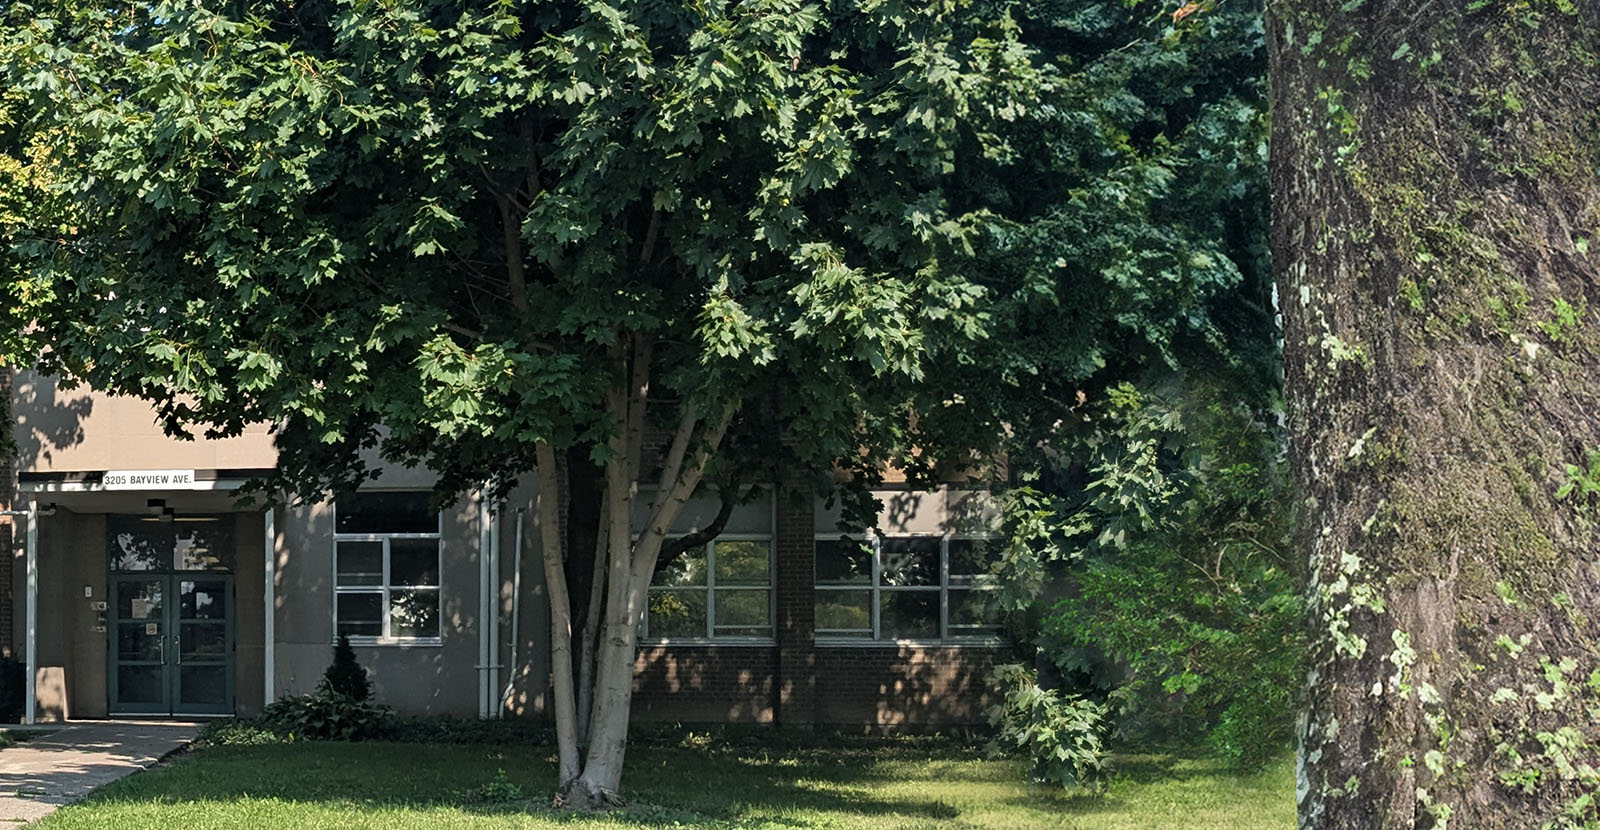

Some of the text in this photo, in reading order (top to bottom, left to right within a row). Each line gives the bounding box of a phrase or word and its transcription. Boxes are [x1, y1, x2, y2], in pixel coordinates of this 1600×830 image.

[105, 474, 192, 485] 3205 BAYVIEW AVE.
